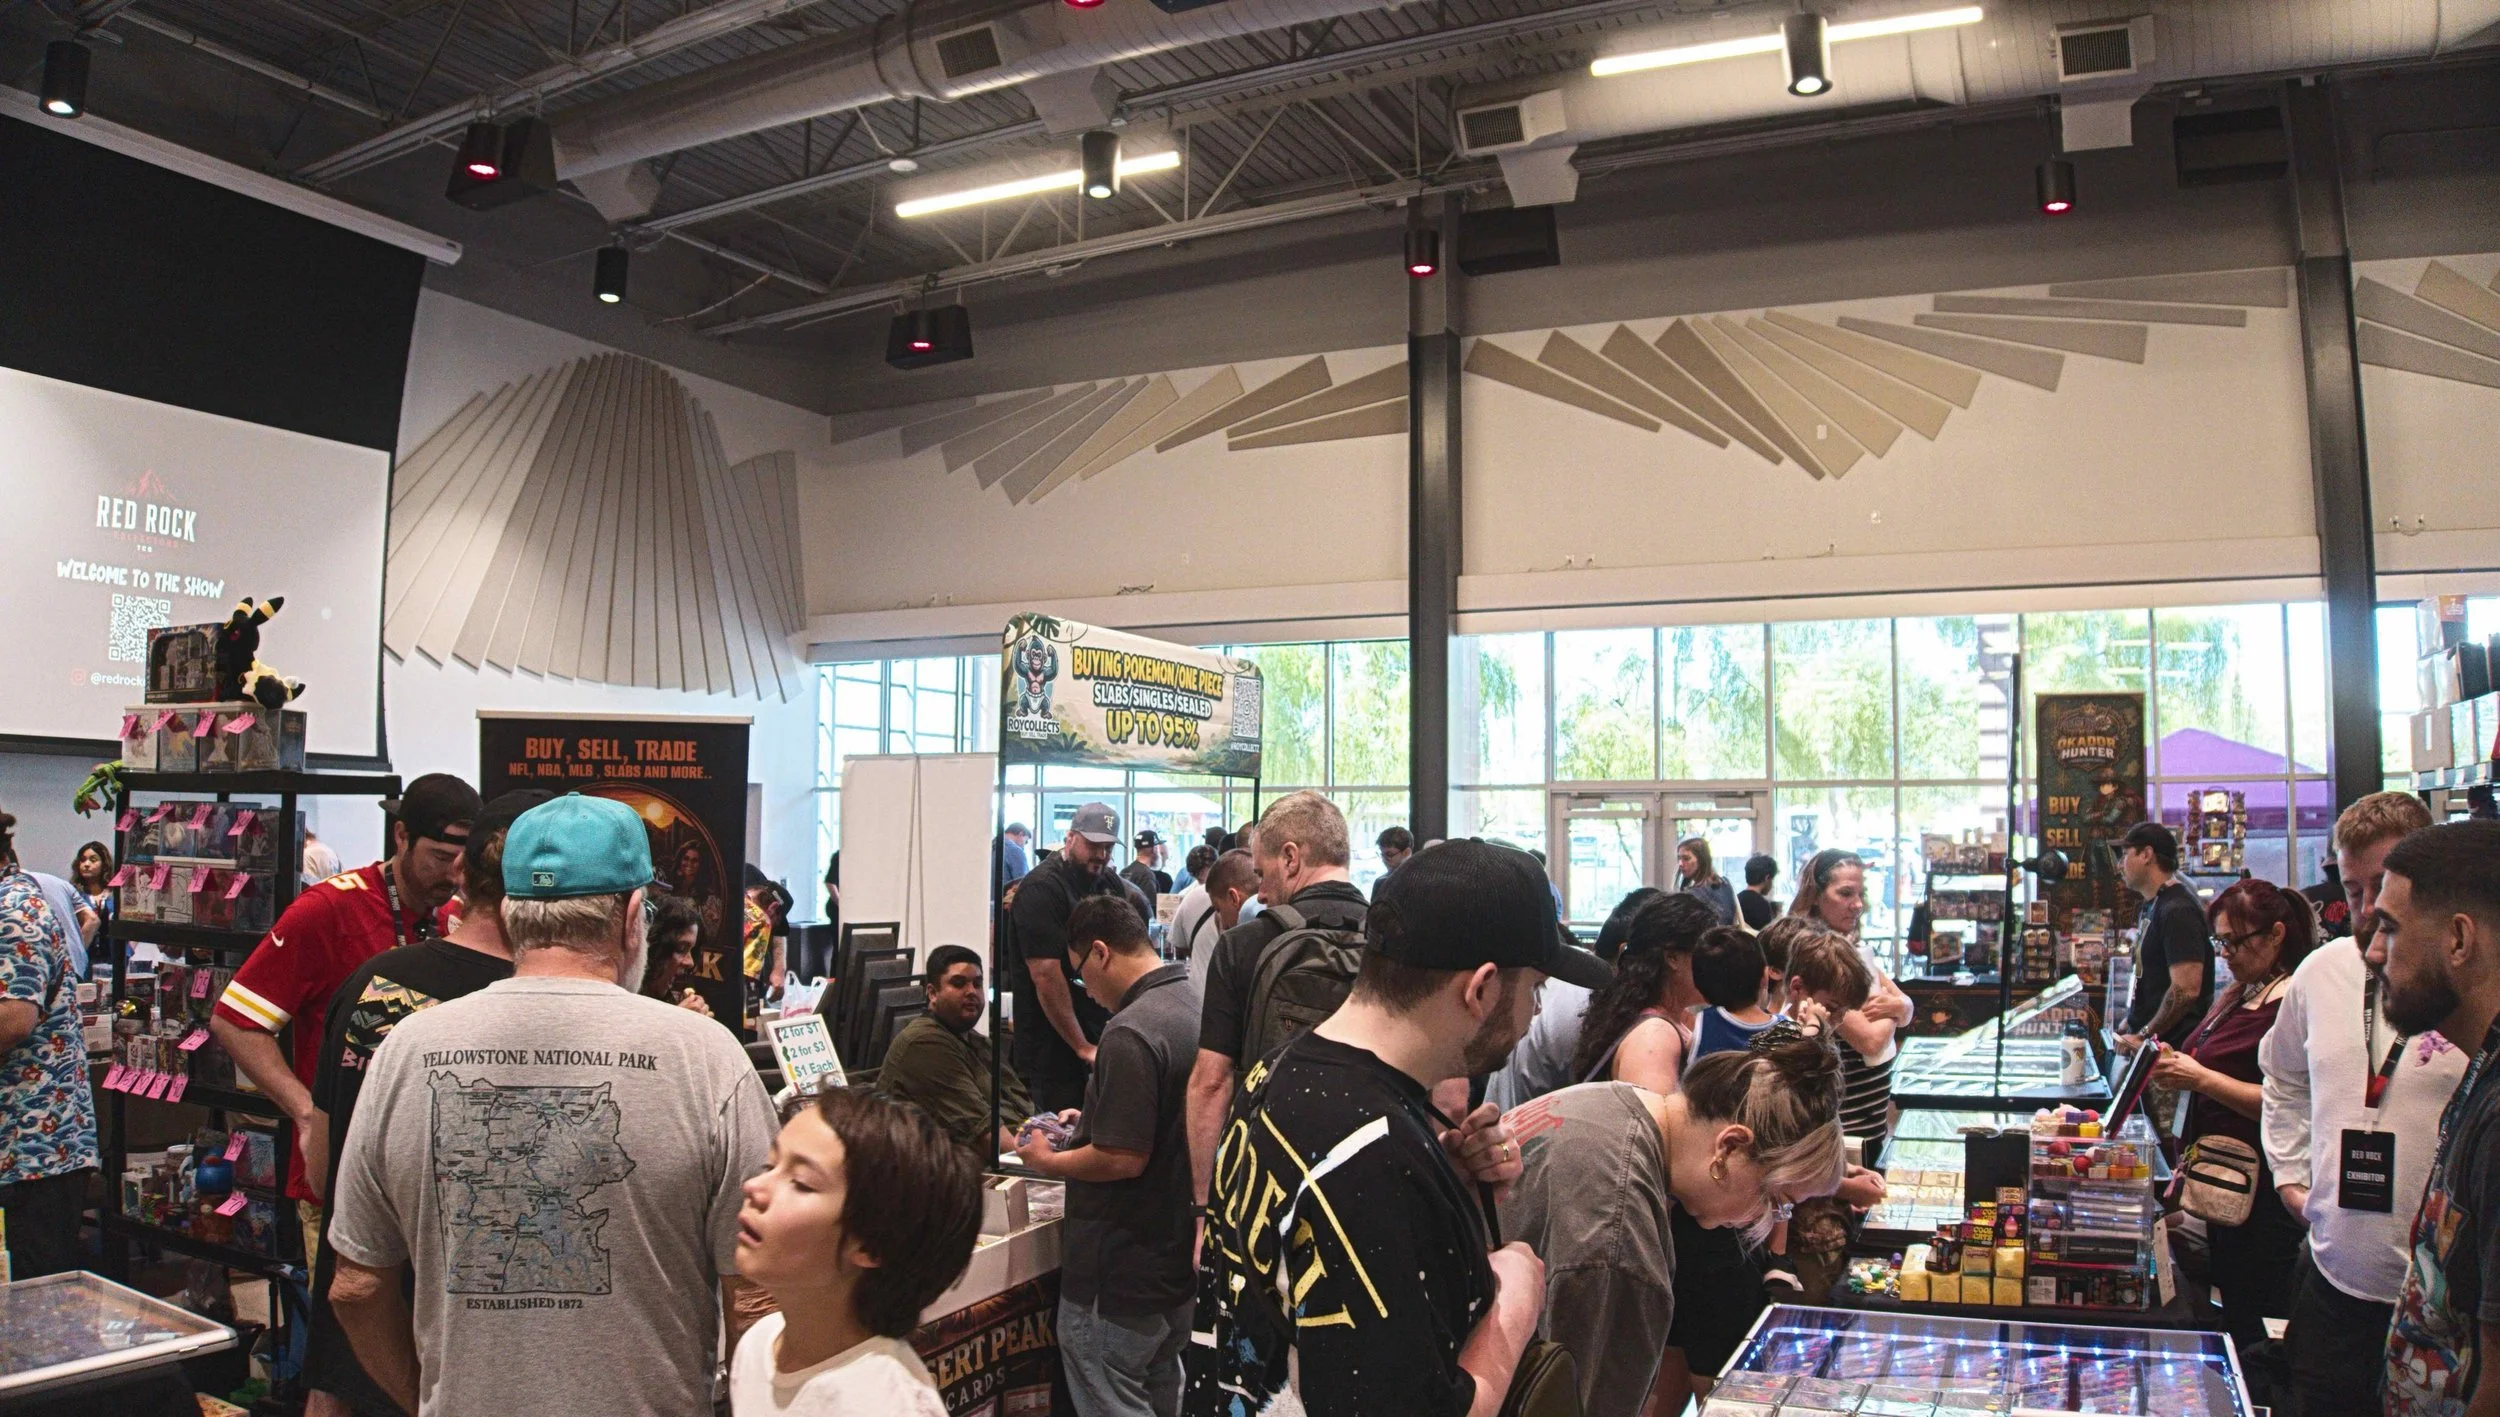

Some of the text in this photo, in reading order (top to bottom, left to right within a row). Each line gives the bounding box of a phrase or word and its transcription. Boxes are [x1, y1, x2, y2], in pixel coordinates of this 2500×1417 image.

[96, 495, 138, 530] RED
[145, 503, 197, 543] ROCK
[56, 558, 225, 599] WELCOME TO THE SHOW
[1073, 647, 1224, 700] BUYING POKEMON/ONE PIECE
[1094, 683, 1213, 720] SLABS/SINGLES/SEALED
[1008, 718, 1060, 733] ROYCOLLECTS
[1106, 709, 1200, 749] UP TO 95%
[526, 738, 697, 764] BUY, SELL, TRADE
[2061, 747, 2115, 760] HUNTER
[537, 764, 565, 780] NBA,
[604, 765, 641, 779] SLABS
[643, 766, 668, 779] AND
[2048, 796, 2081, 815] BUY
[2046, 828, 2082, 847] SELL
[781, 1023, 819, 1039] 2 for $1
[2015, 1021, 2063, 1036] HUNT
[790, 1041, 826, 1058] 2 for $3
[423, 1050, 658, 1072] YELLOWSTONE NATIONAL PARK
[794, 1060, 834, 1077] $1 Each
[2351, 1149, 2365, 1160] RED
[2346, 1170, 2386, 1183] EXHIBITOR
[466, 1297, 584, 1310] ESTABLISHED 1872
[925, 1308, 1057, 1390] SERT PEAK
[945, 1366, 1006, 1412] CARDS
